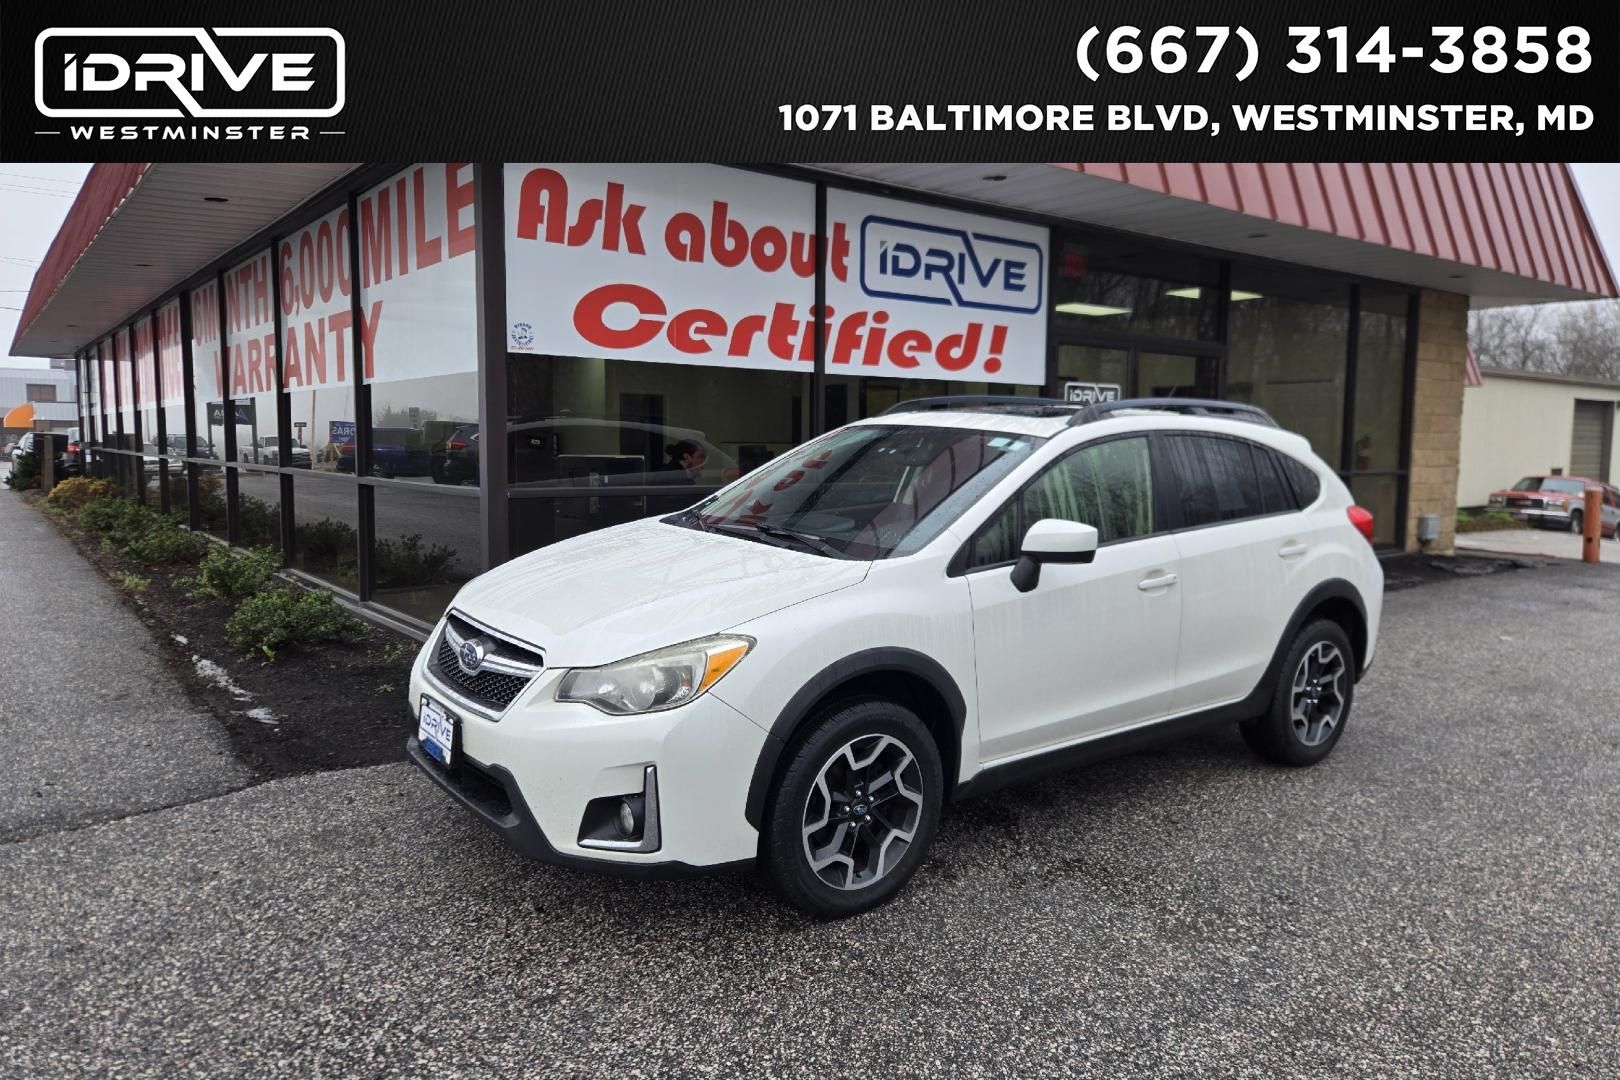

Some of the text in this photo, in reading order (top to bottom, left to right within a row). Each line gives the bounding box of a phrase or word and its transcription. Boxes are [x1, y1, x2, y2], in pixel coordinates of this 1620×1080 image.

[279, 206, 352, 318] 6,000
[361, 163, 475, 289] MILE
[517, 168, 647, 256] Ask
[664, 200, 850, 283] about
[573, 283, 1009, 374] Certified!
